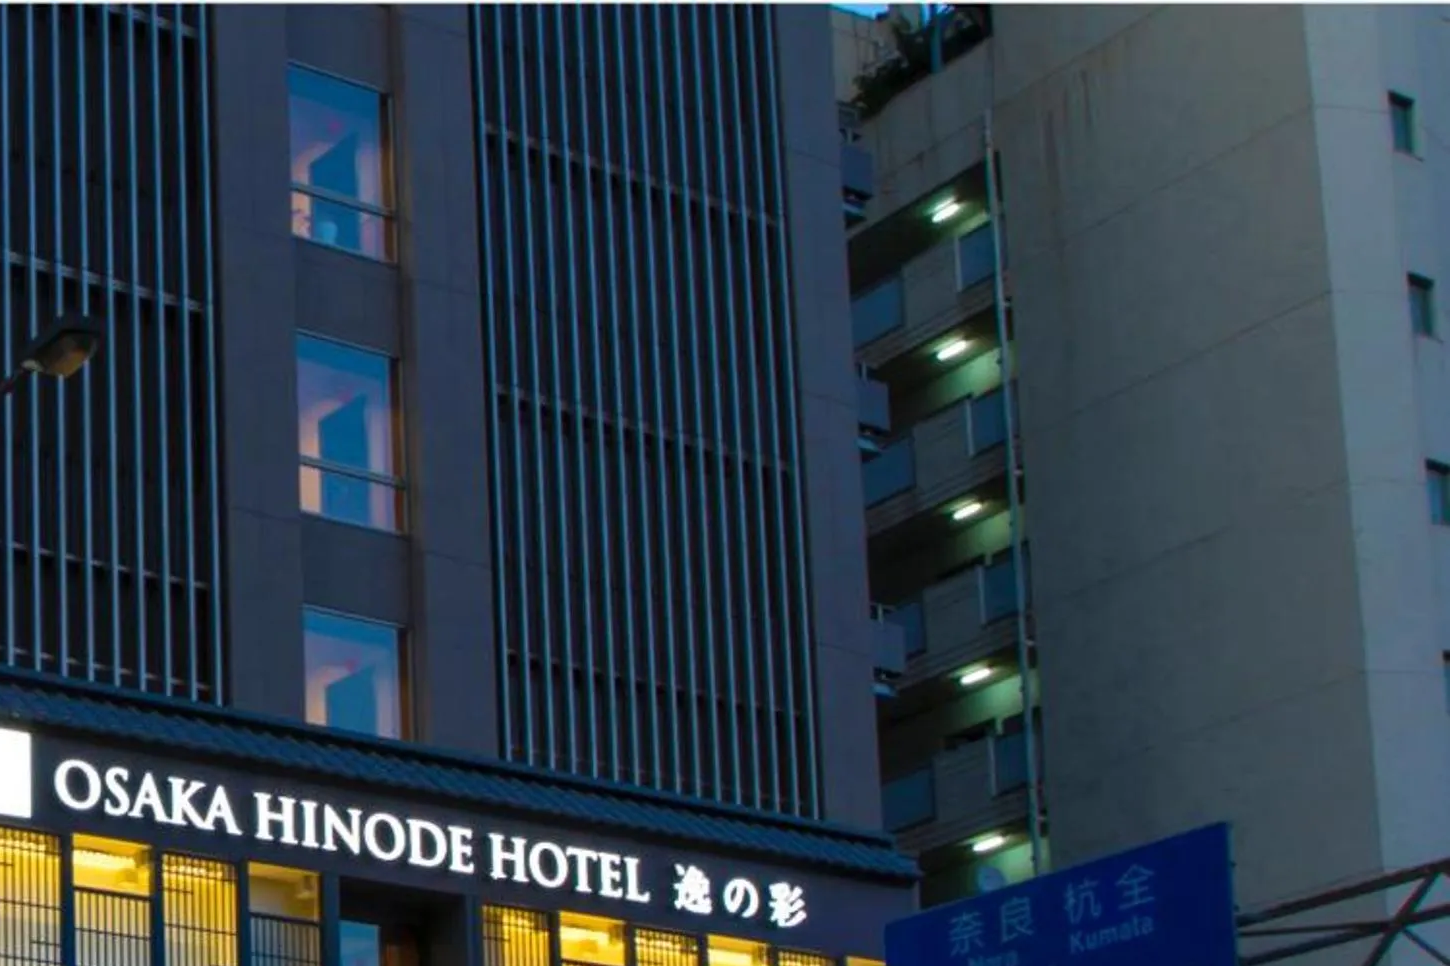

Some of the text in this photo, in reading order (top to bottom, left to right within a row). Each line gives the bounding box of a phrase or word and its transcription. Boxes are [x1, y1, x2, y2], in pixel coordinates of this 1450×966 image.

[54, 758, 243, 837] OSAKA
[253, 791, 476, 874] HINODE
[486, 832, 651, 903] HOTEL
[1063, 863, 1156, 925] 杭全
[948, 896, 1036, 957] 奈良
[1069, 914, 1155, 954] Kumata
